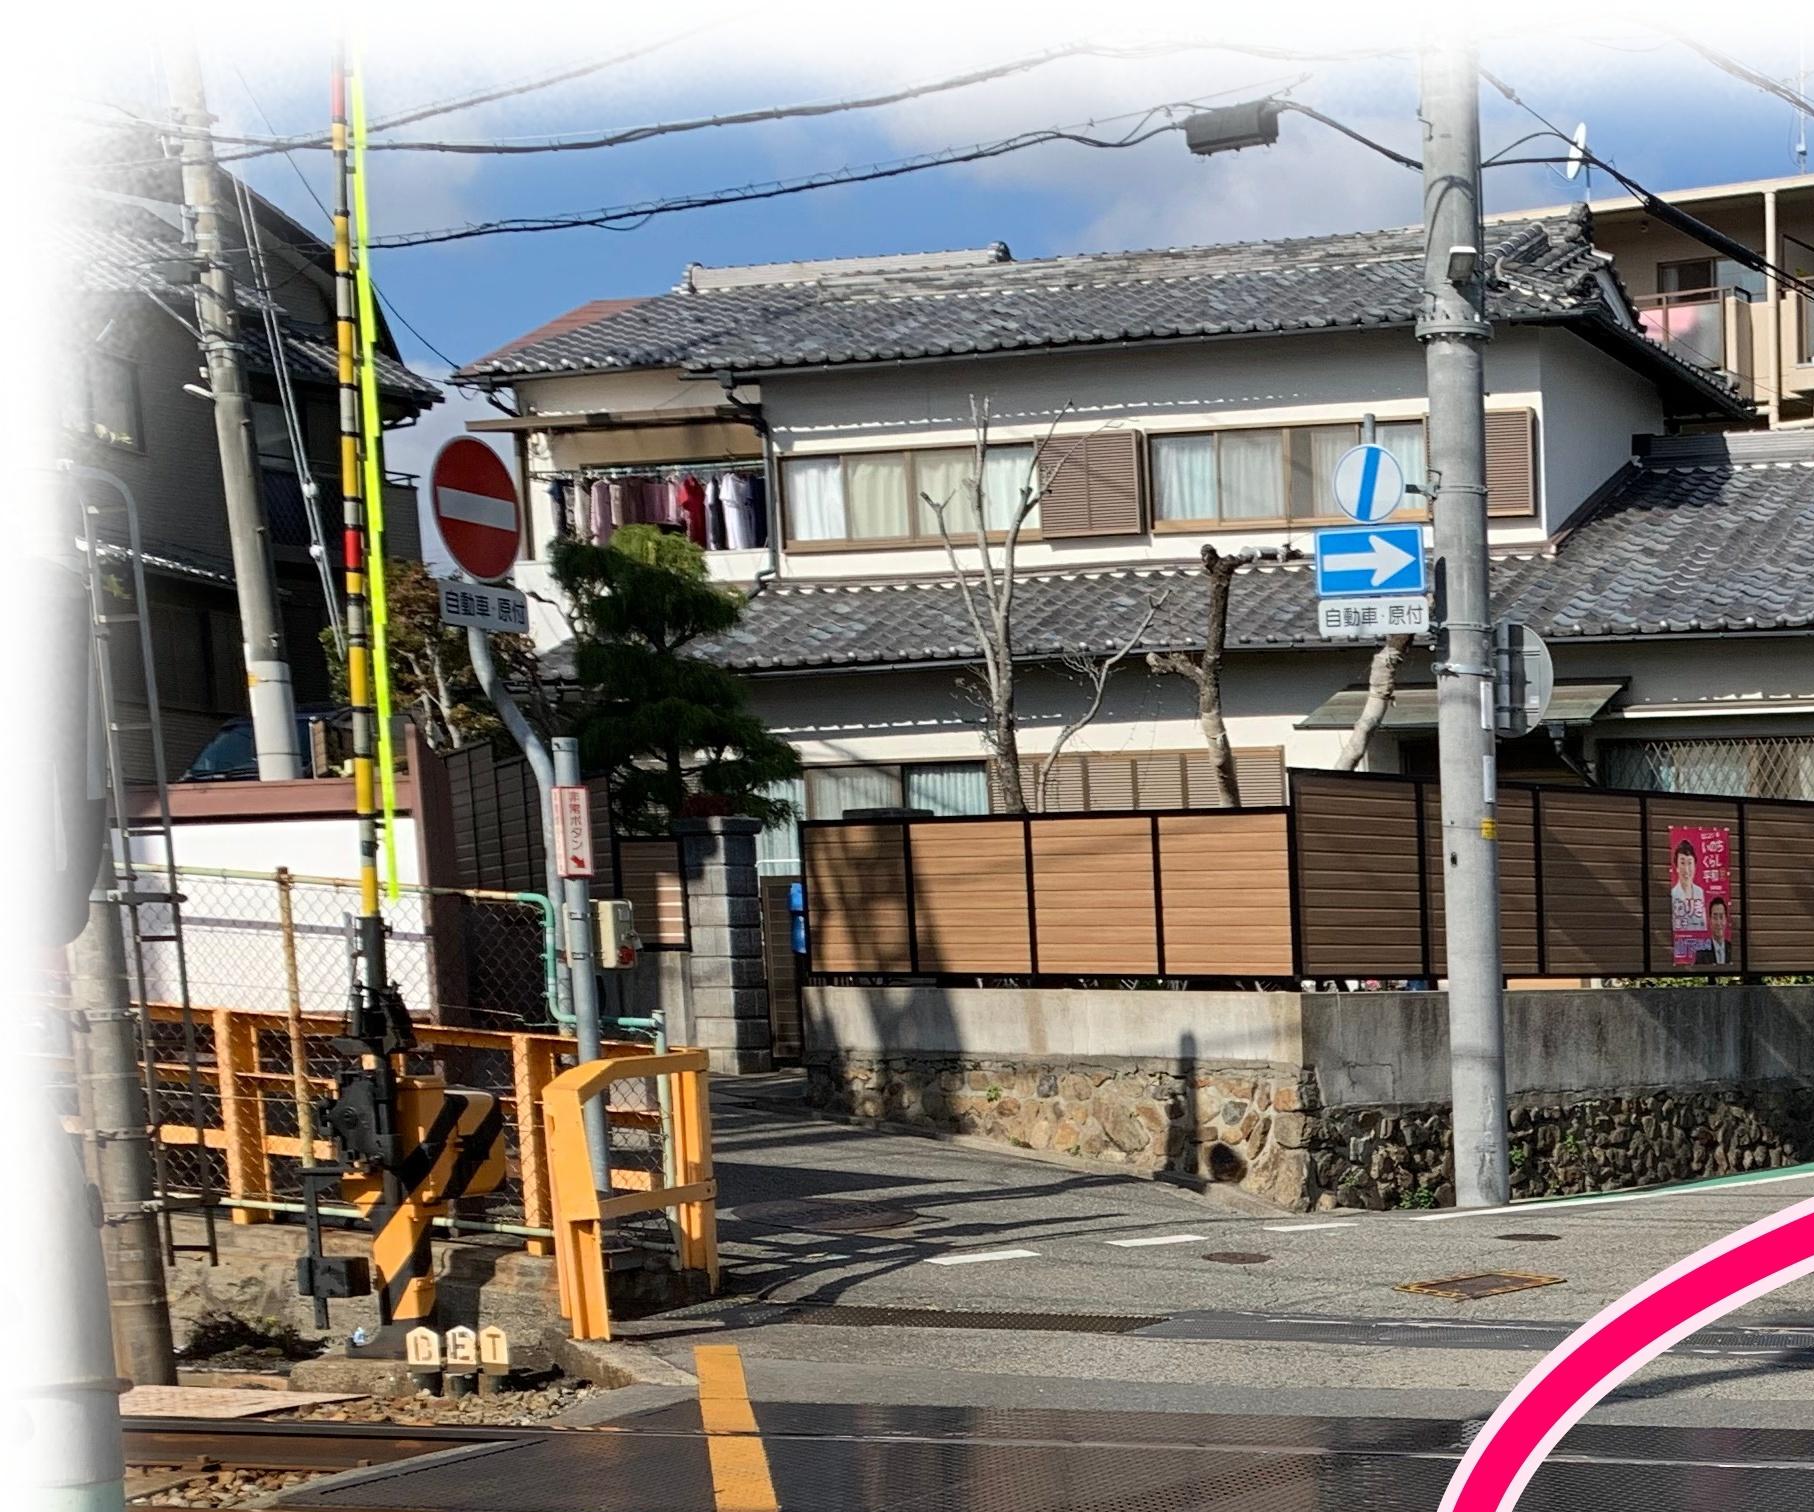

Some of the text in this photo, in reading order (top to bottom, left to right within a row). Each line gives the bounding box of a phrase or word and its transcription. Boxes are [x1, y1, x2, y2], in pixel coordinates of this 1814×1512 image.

[567, 791, 584, 851] 非常ボタン
[1702, 854, 1722, 868] くらし
[486, 1333, 501, 1361] T
